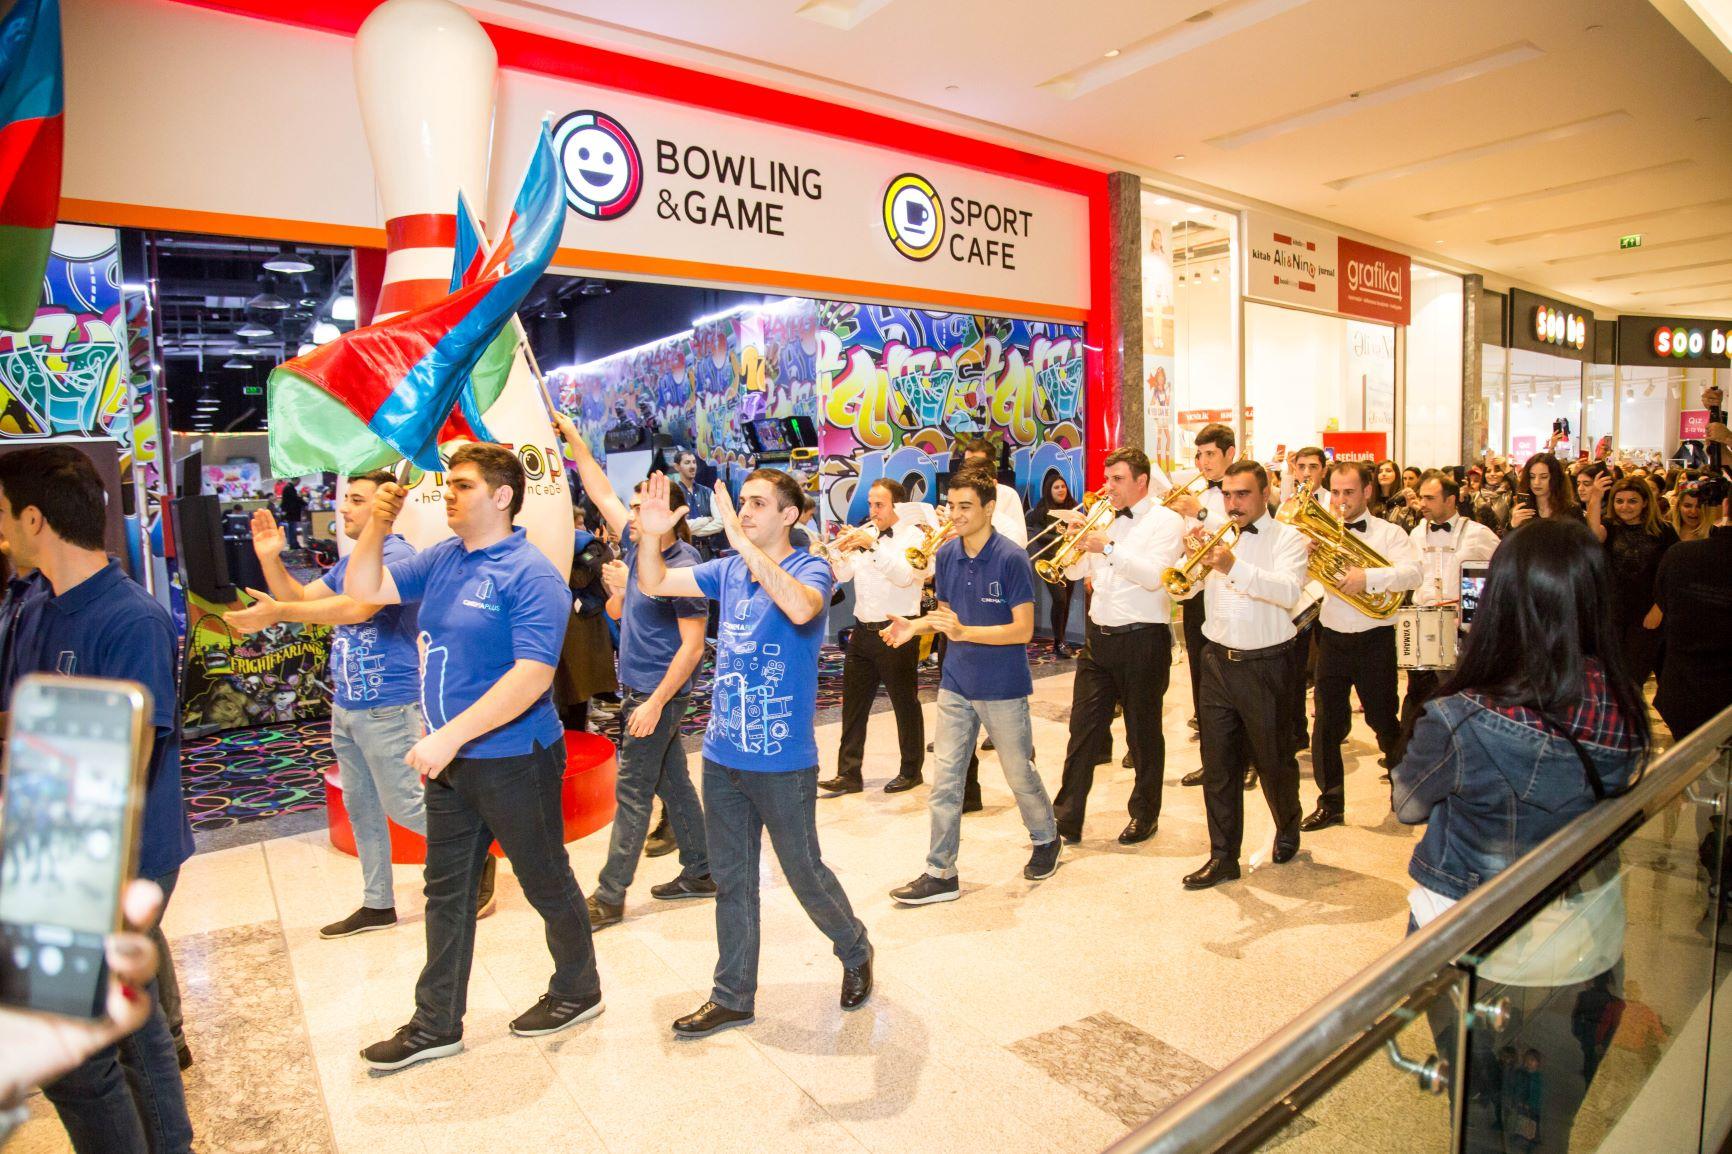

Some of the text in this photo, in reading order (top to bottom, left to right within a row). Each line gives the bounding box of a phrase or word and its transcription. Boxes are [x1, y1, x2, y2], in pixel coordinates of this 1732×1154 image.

[656, 139, 822, 200] BOWLING
[657, 188, 785, 236] &GAME
[950, 197, 1033, 238] SPORT
[949, 233, 1016, 270] CAFE
[1252, 249, 1271, 261] kitab
[1318, 265, 1335, 277] jurnal
[1657, 330, 1703, 354] soo
[1403, 628, 1411, 656] YAMAHA
